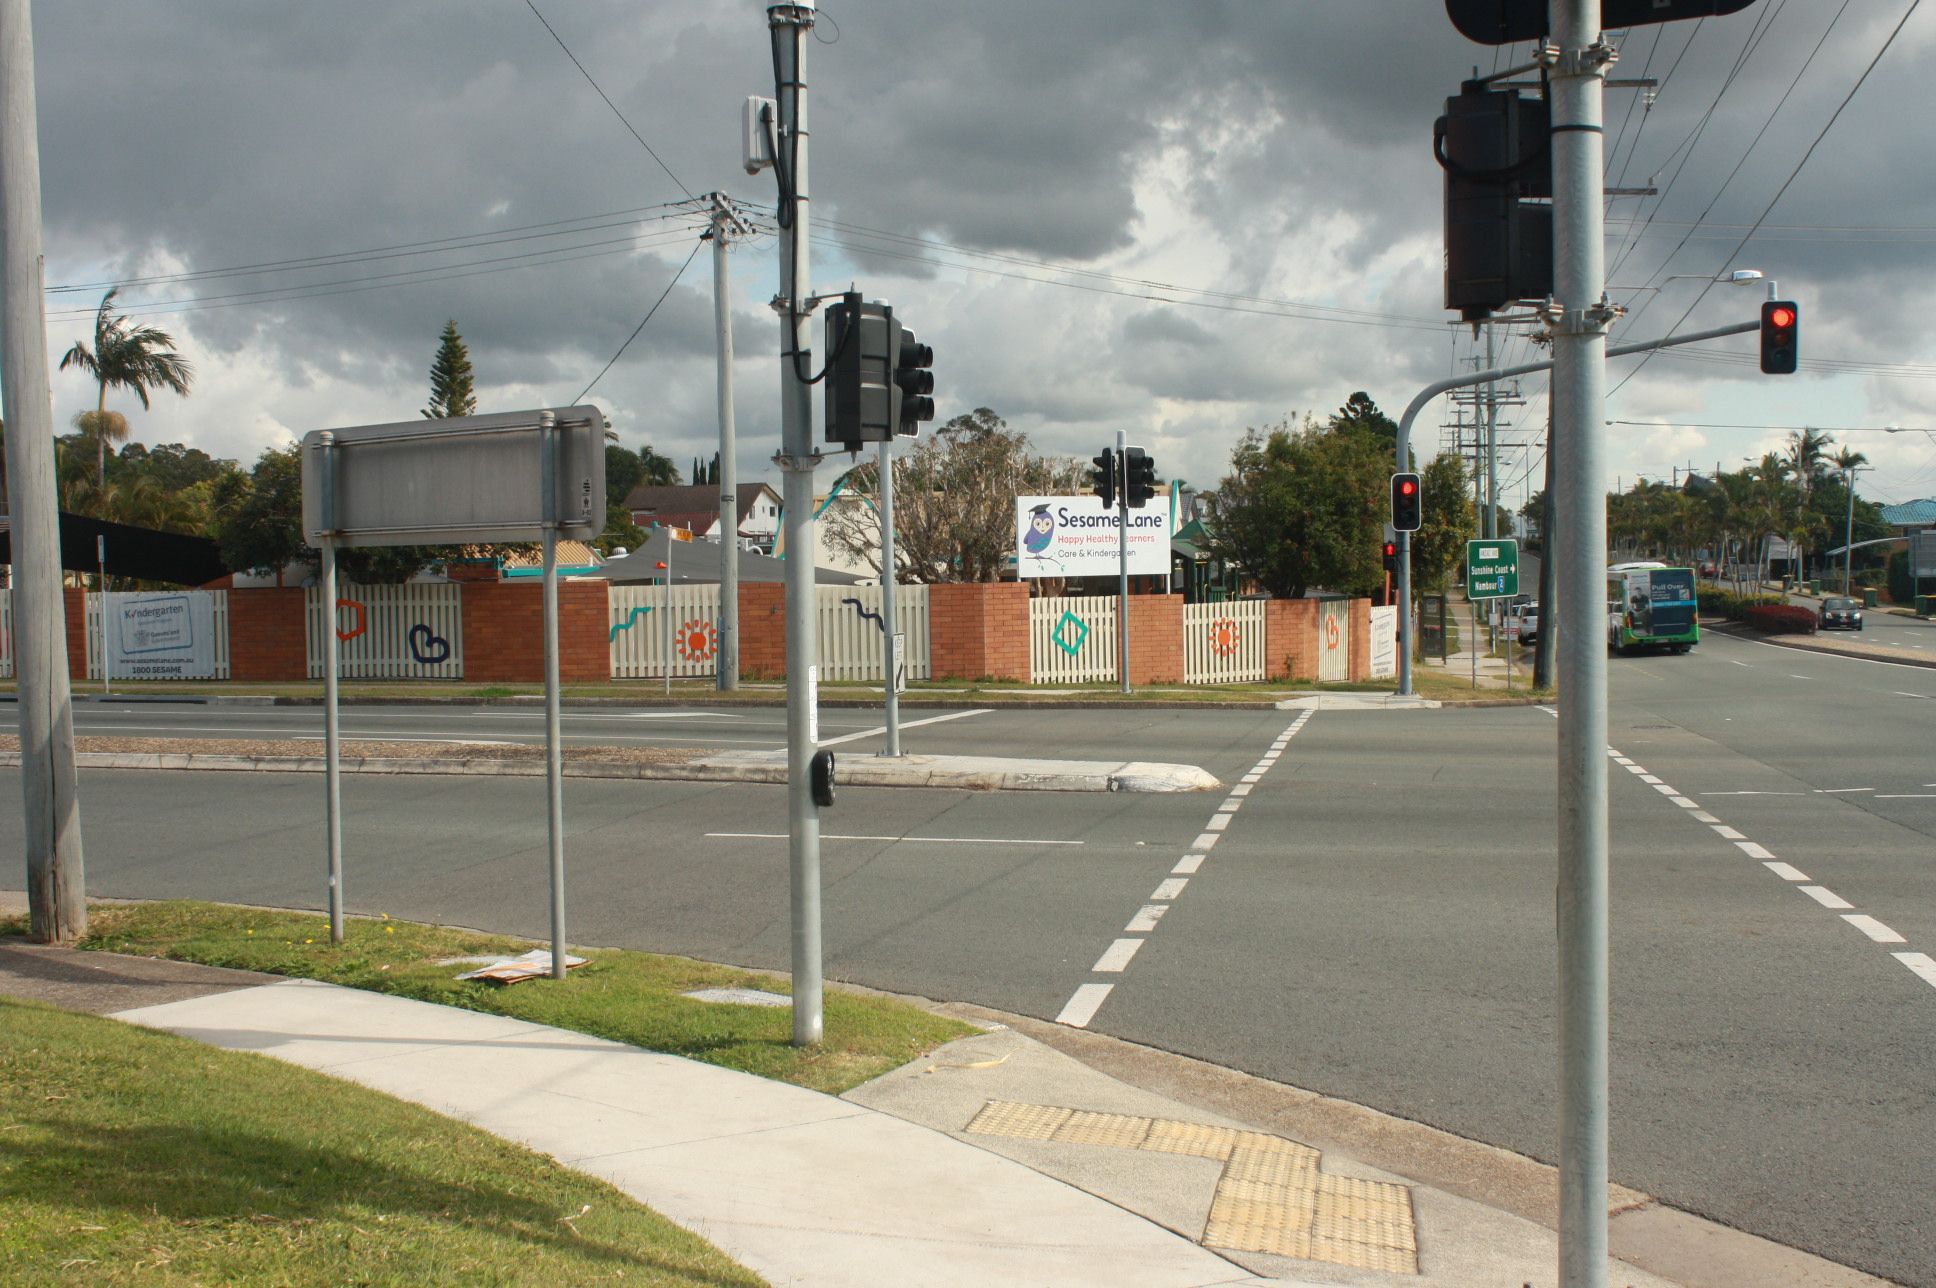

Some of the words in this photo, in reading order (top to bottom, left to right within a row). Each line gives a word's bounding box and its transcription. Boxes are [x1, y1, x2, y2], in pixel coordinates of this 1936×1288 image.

[1058, 507, 1120, 528] Sesame
[1126, 508, 1162, 528] Lane
[1058, 535, 1084, 545] Happy
[1086, 534, 1118, 545] Healthy
[1058, 550, 1077, 558] Care
[1079, 549, 1085, 558] &
[1087, 549, 1136, 559] Kindergaen
[1471, 566, 1494, 576] Sunshine
[1495, 565, 1509, 574] Coast
[132, 666, 151, 674] 1800
[152, 666, 182, 674] SESAME
